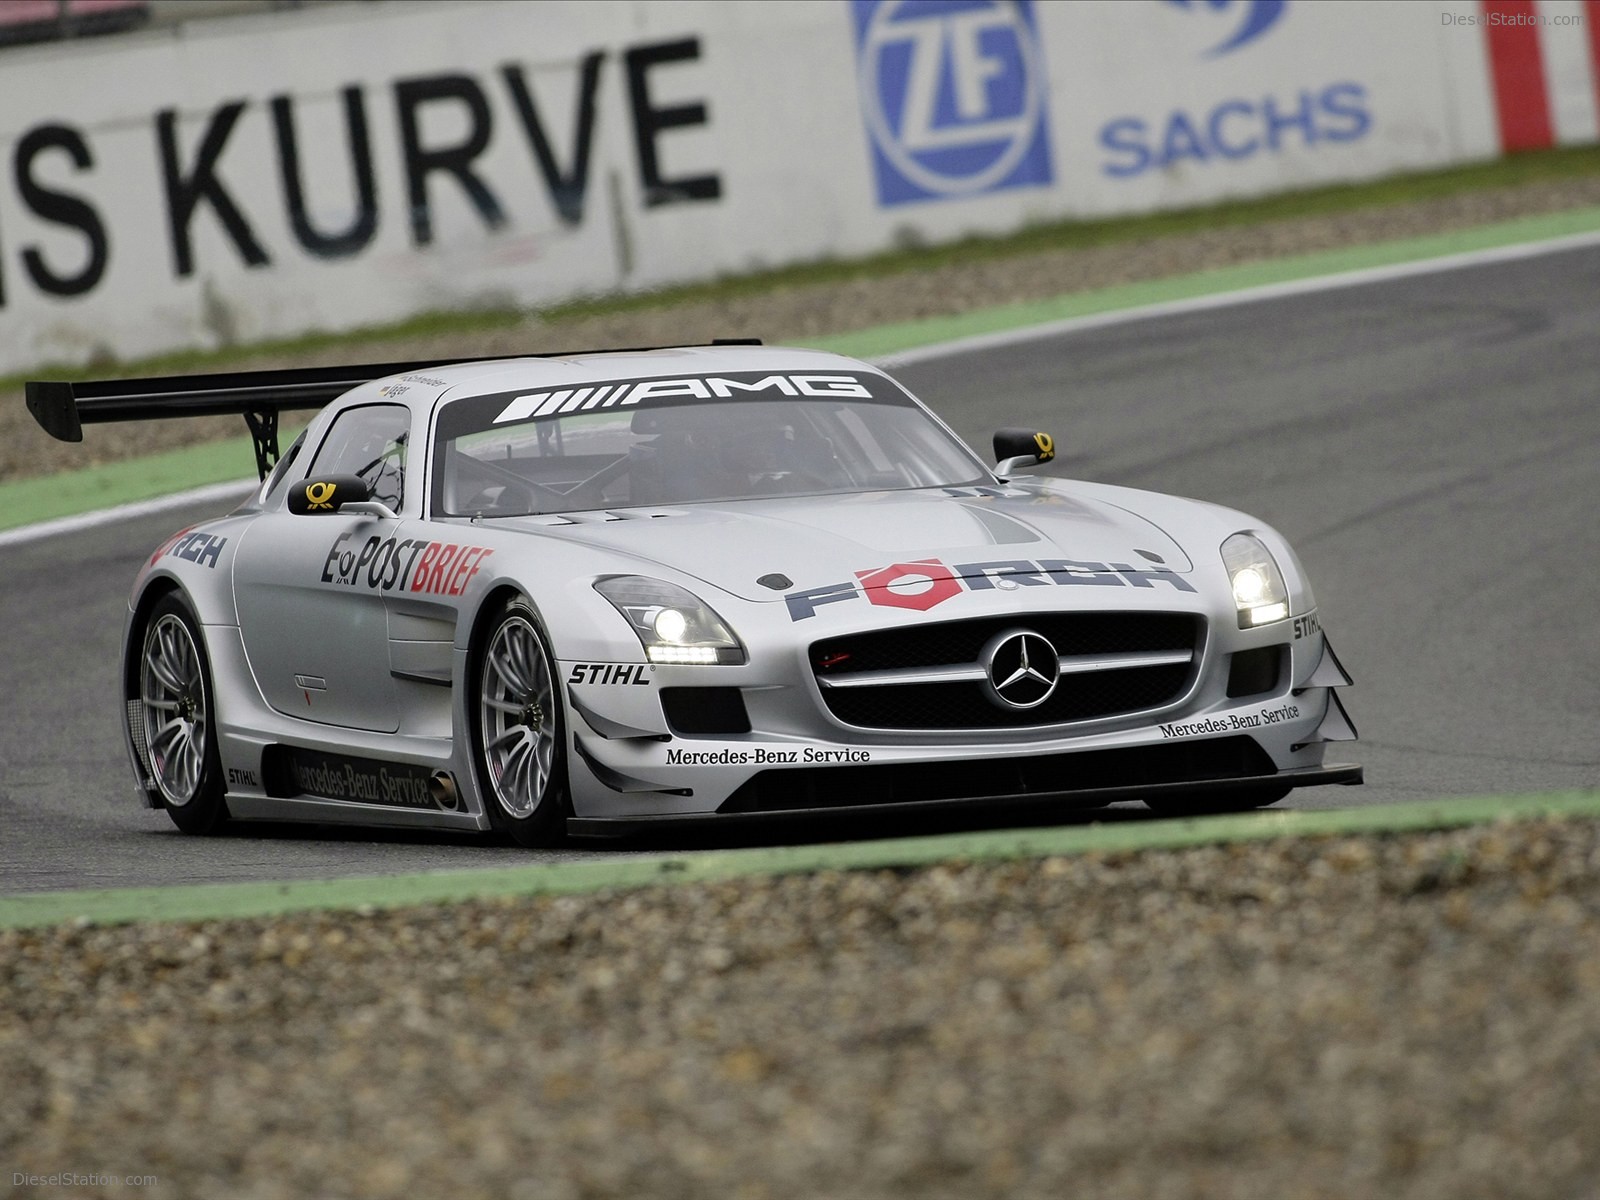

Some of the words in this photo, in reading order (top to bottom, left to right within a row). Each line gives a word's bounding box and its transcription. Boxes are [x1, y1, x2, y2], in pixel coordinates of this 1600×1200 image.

[873, 6, 1028, 150] ZF
[1098, 79, 1373, 179] SACHS
[155, 36, 723, 279] KURVE
[1293, 613, 1321, 640] STIHL
[1159, 713, 1261, 739] Mercedes-Benz
[1260, 704, 1300, 725] Service
[665, 748, 798, 766] Mercedes-Benz
[802, 747, 871, 764] Service
[228, 768, 257, 787] STIHL
[379, 766, 429, 804] Service
